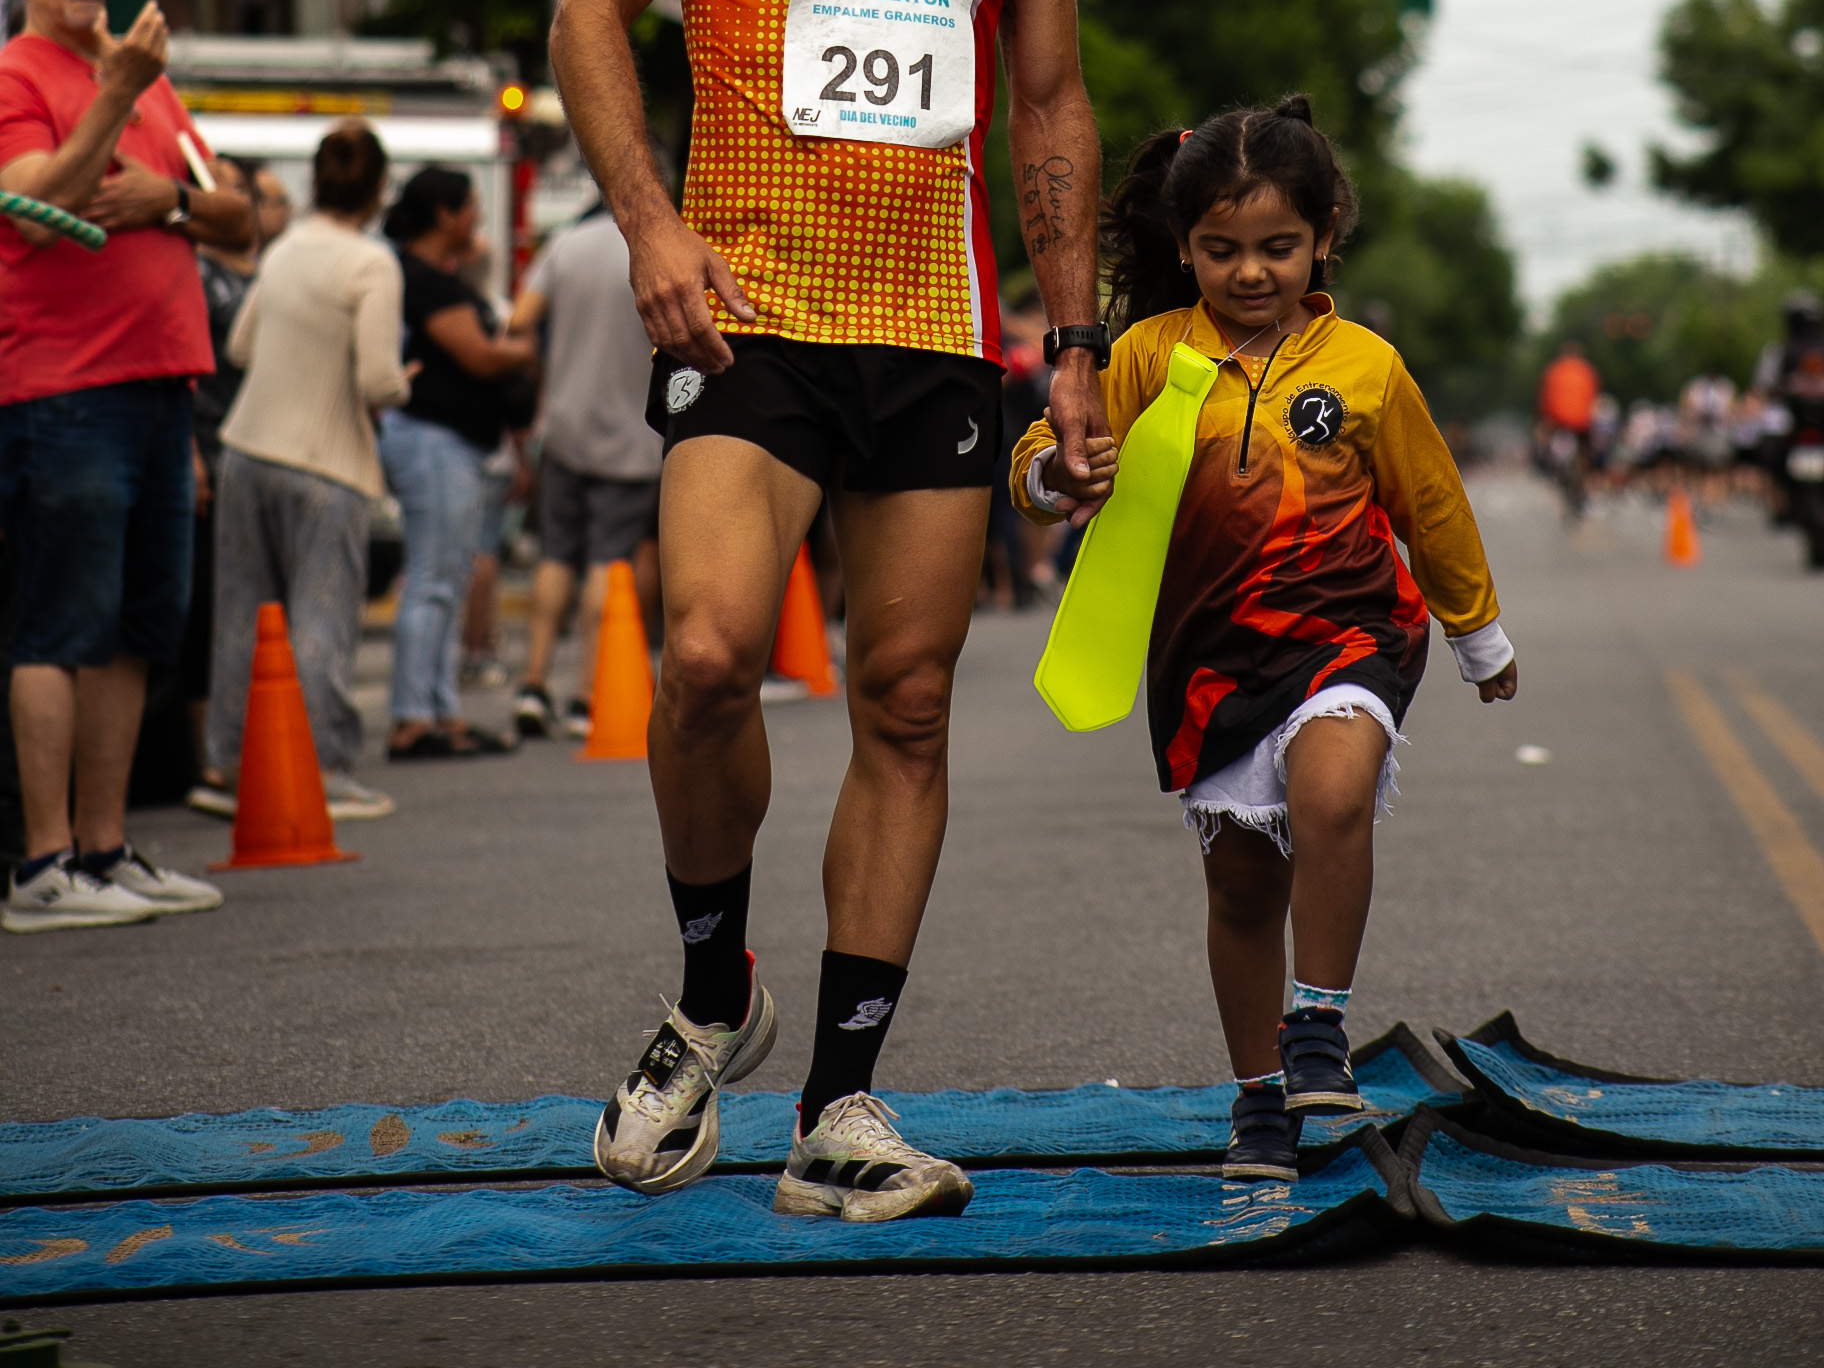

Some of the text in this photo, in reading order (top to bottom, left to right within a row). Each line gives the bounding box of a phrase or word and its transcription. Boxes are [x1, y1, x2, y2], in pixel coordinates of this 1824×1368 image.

[812, 4, 955, 28] EMPALME GRANEROS
[819, 45, 933, 111] 291
[792, 107, 821, 123] NEJ
[840, 110, 917, 128] DIA DEL VECINO
[1036, 156, 1073, 249] Olivia
[1284, 393, 1295, 404] de
[1296, 381, 1350, 422] Entrenamiento
[1283, 407, 1296, 439] Grupo
